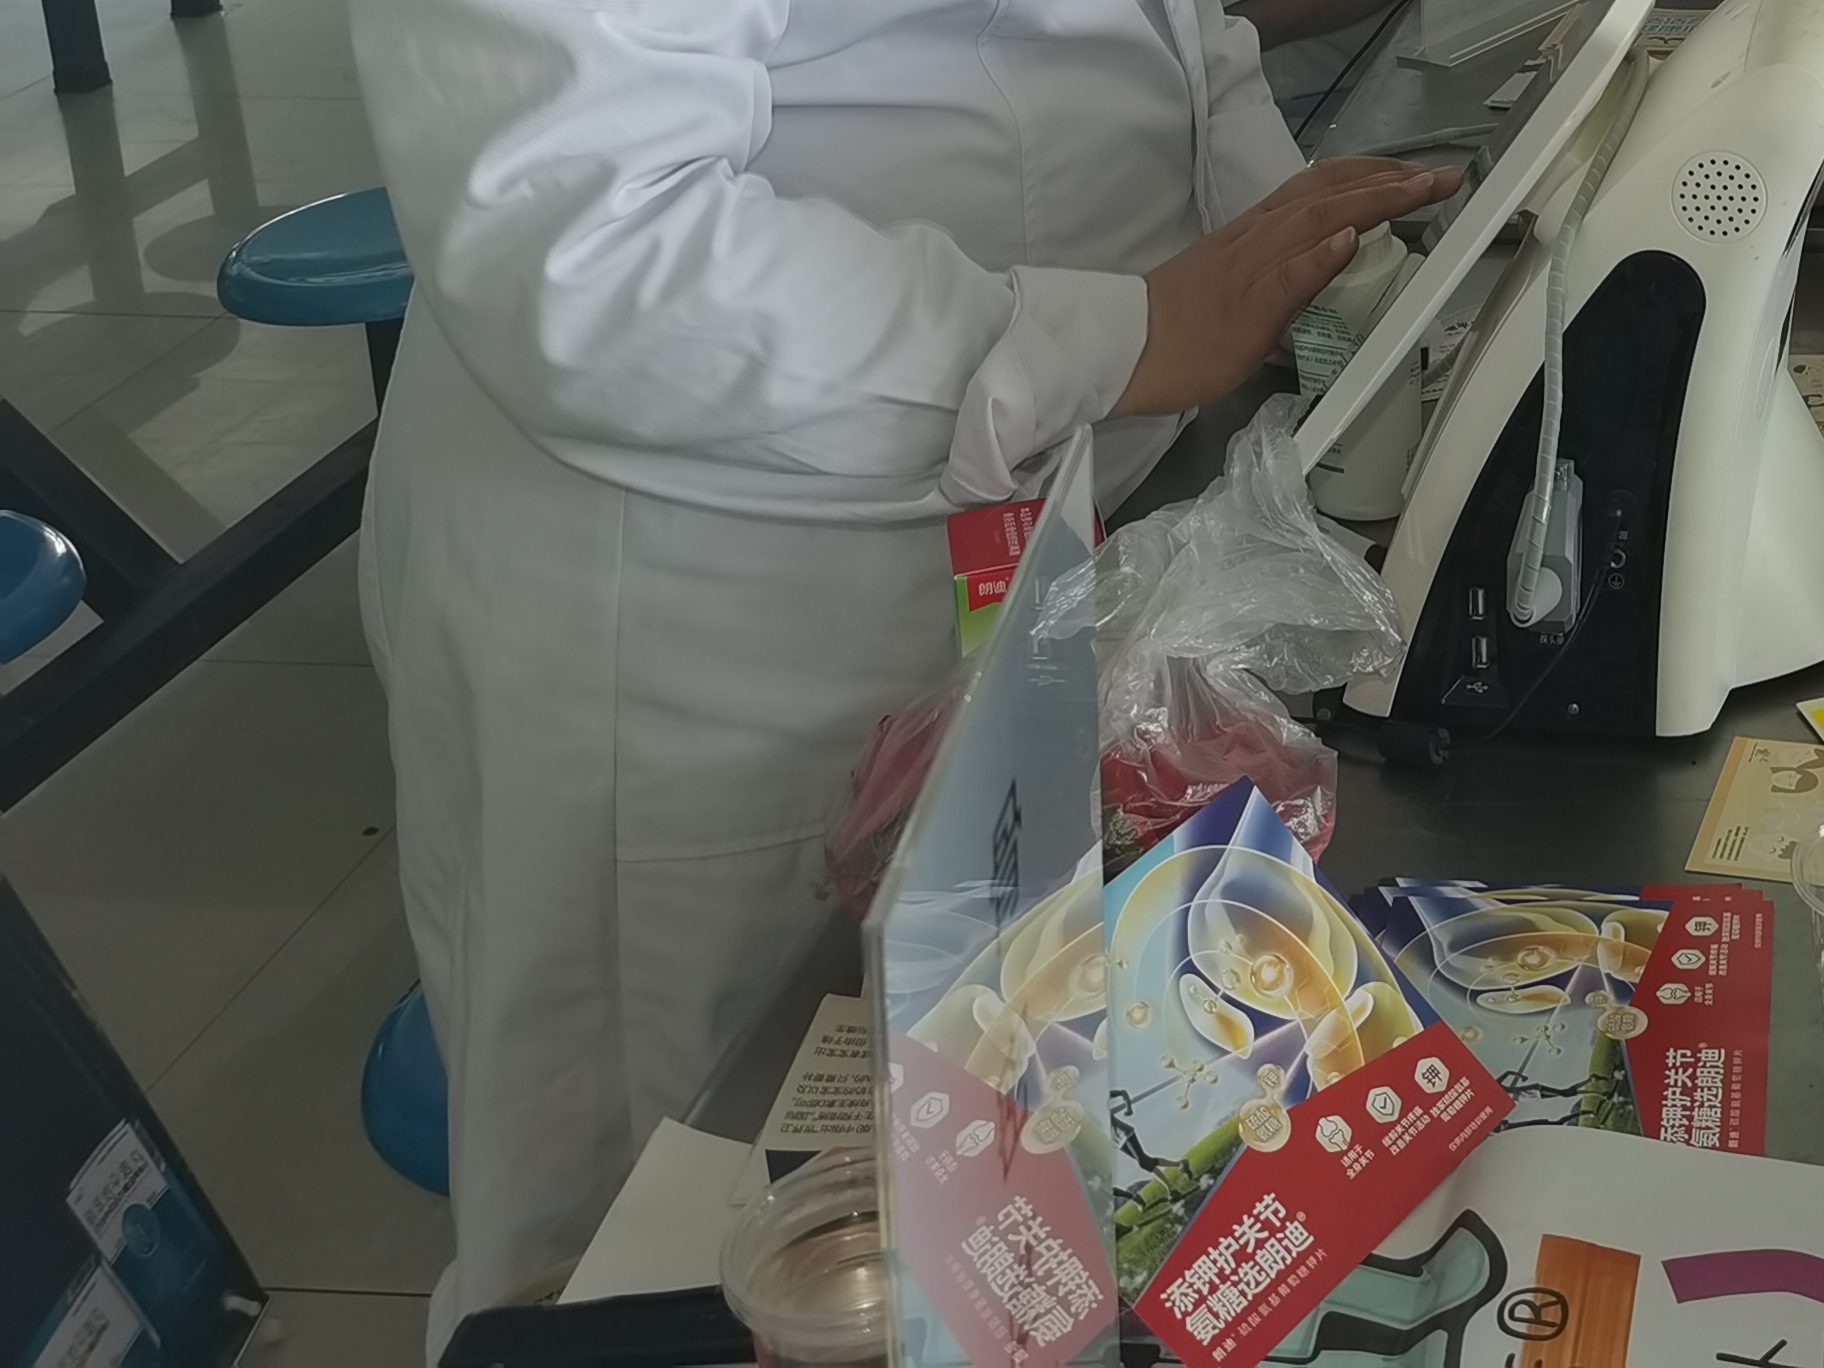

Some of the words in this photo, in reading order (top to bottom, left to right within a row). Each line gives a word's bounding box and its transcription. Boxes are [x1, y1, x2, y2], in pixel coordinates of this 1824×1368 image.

[1418, 1062, 1446, 1090] 钾
[1659, 1046, 1694, 1144] 添钾护关节
[1158, 1189, 1291, 1321] 添钾护关节
